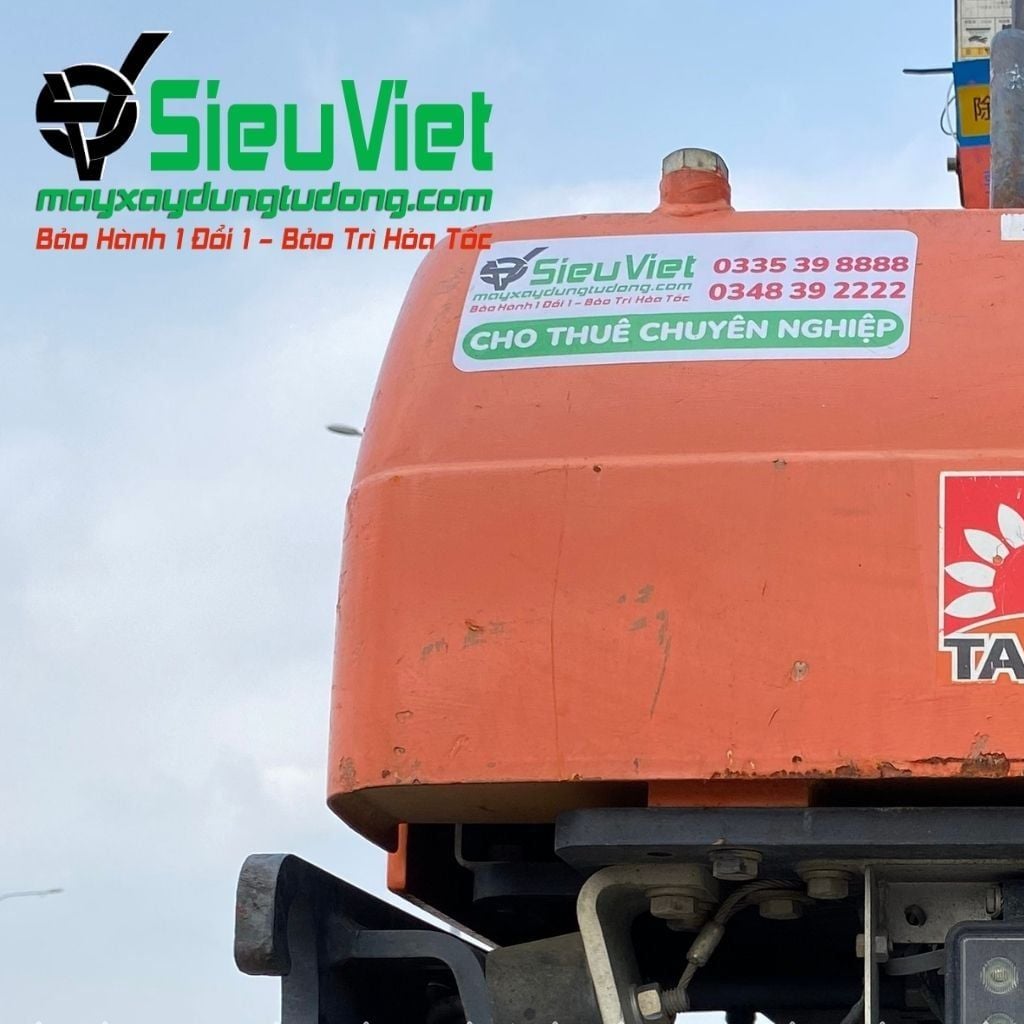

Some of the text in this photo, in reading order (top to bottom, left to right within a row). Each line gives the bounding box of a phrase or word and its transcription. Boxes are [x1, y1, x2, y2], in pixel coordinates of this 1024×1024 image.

[529, 253, 697, 286] SieuViet
[713, 256, 909, 274] 0335 39 8888
[472, 282, 693, 302] mayxaydungtudong.com
[708, 281, 907, 300] 0348 39 2222
[469, 312, 898, 351] CHO THUÊ CHUYÊN NGHIỆP
